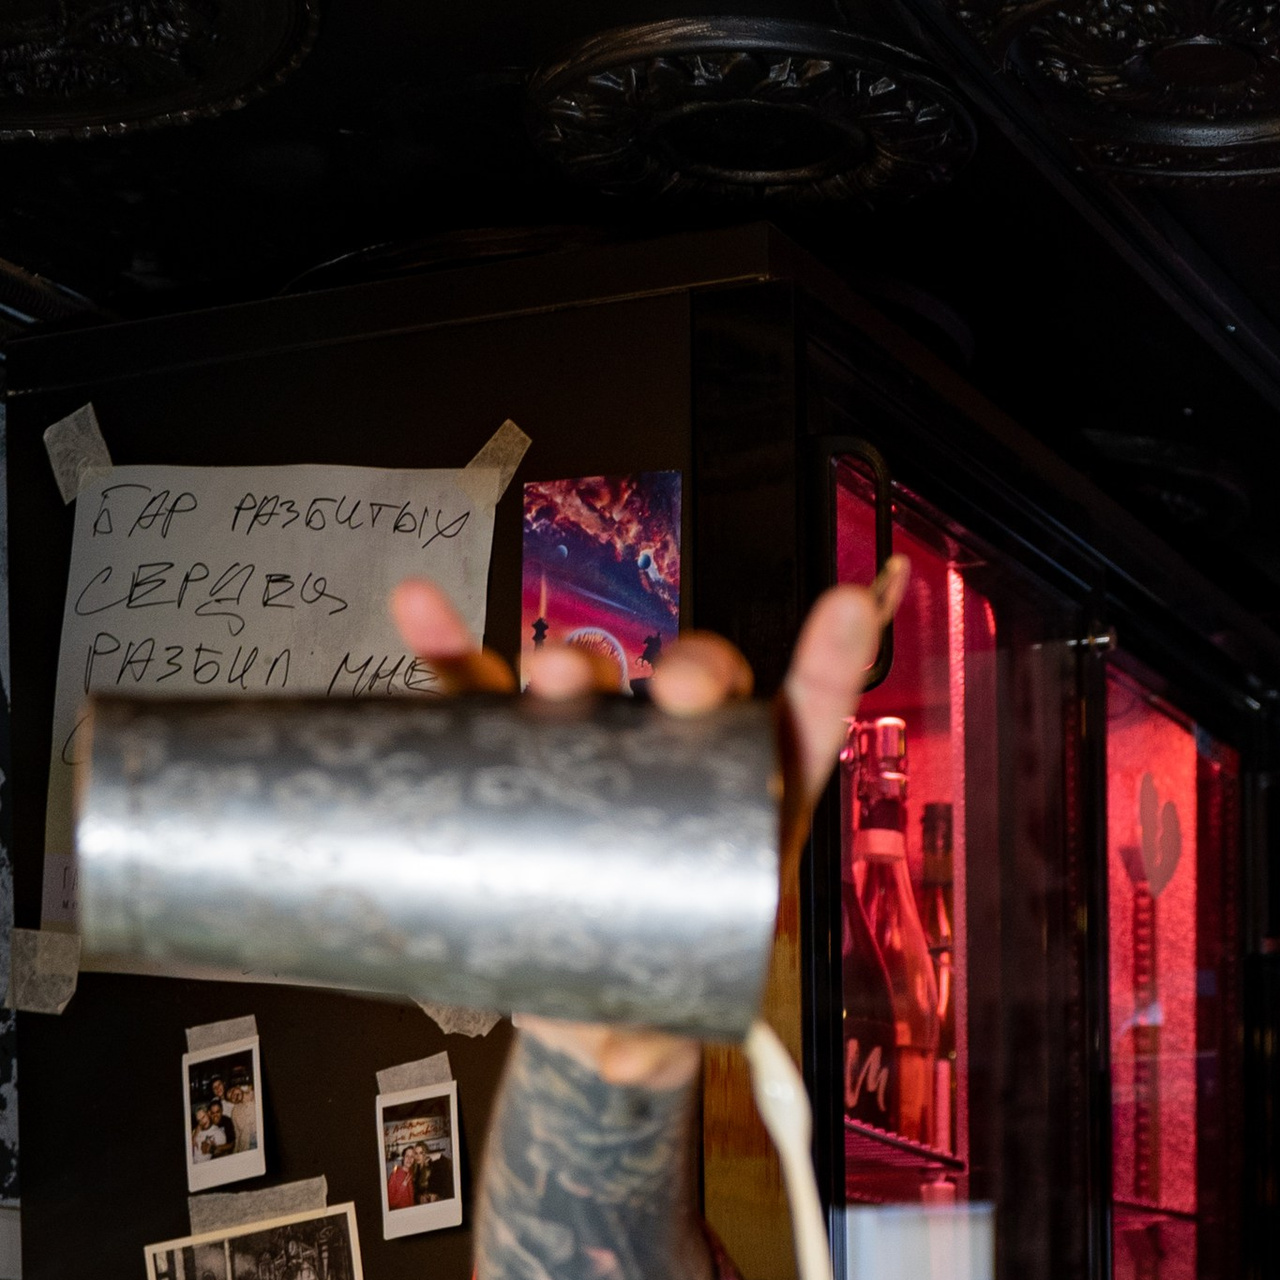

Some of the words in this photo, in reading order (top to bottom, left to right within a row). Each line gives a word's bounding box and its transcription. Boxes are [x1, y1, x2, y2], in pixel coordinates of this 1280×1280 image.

[93, 484, 197, 538] БАР
[232, 492, 470, 548] РАЗБИТЫХ
[84, 632, 290, 692] РАЗБИЛ
